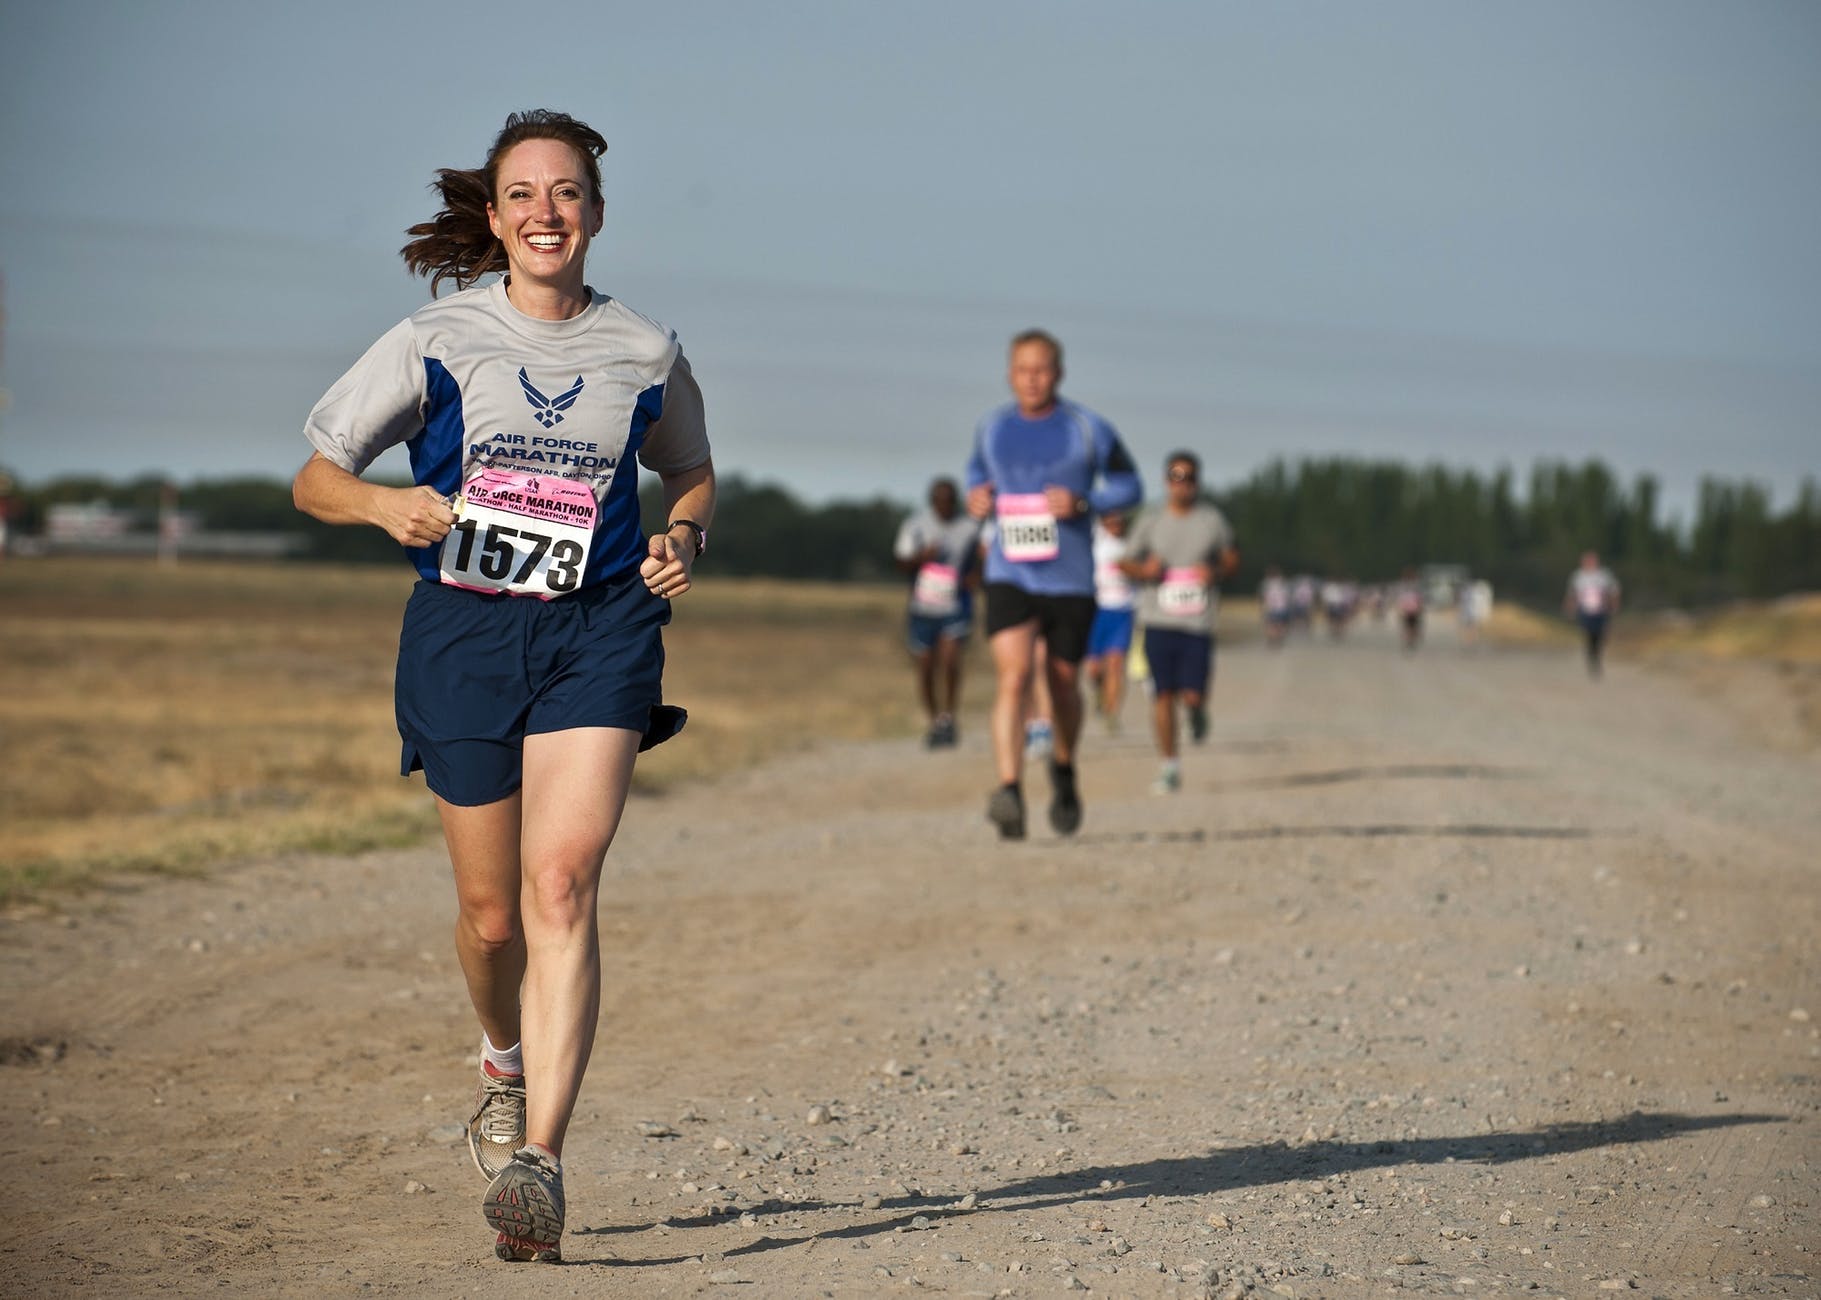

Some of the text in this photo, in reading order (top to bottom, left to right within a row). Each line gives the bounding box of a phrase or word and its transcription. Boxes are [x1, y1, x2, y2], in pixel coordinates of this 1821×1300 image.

[469, 443, 617, 469] MARATHON
[491, 432, 598, 453] AIR FORCE
[467, 496, 503, 507] MATHON
[508, 503, 528, 512] HALF
[528, 507, 570, 521] MARATHON
[575, 517, 589, 525] 10K
[468, 485, 594, 518] AIR ORCE MARATHON
[455, 518, 584, 592] 1573
